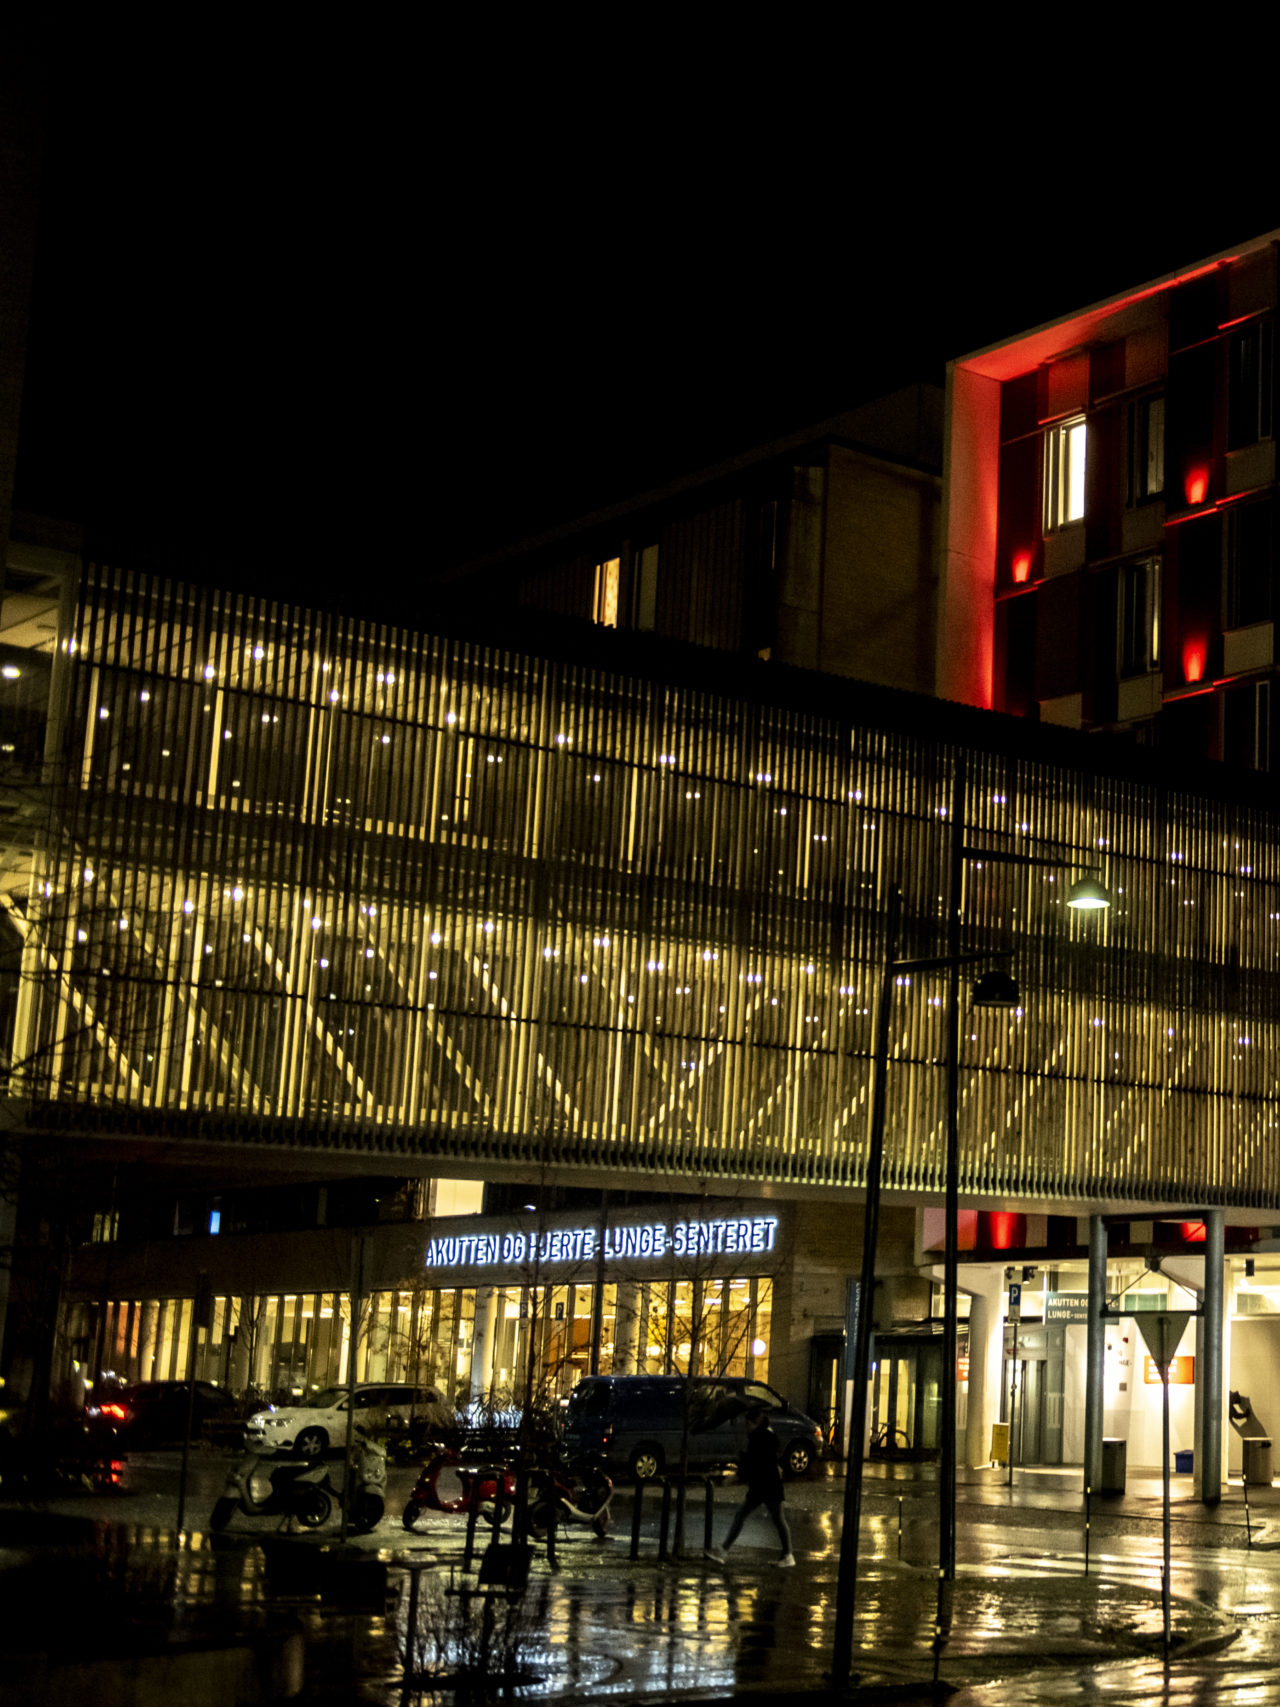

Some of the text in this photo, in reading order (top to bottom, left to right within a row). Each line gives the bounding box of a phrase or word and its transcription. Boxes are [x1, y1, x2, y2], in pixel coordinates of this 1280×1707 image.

[427, 1234, 499, 1266] AKUTTEN
[502, 1231, 526, 1263] OG
[1011, 1286, 1019, 1303] P
[1048, 1297, 1079, 1307] AKUTTEN
